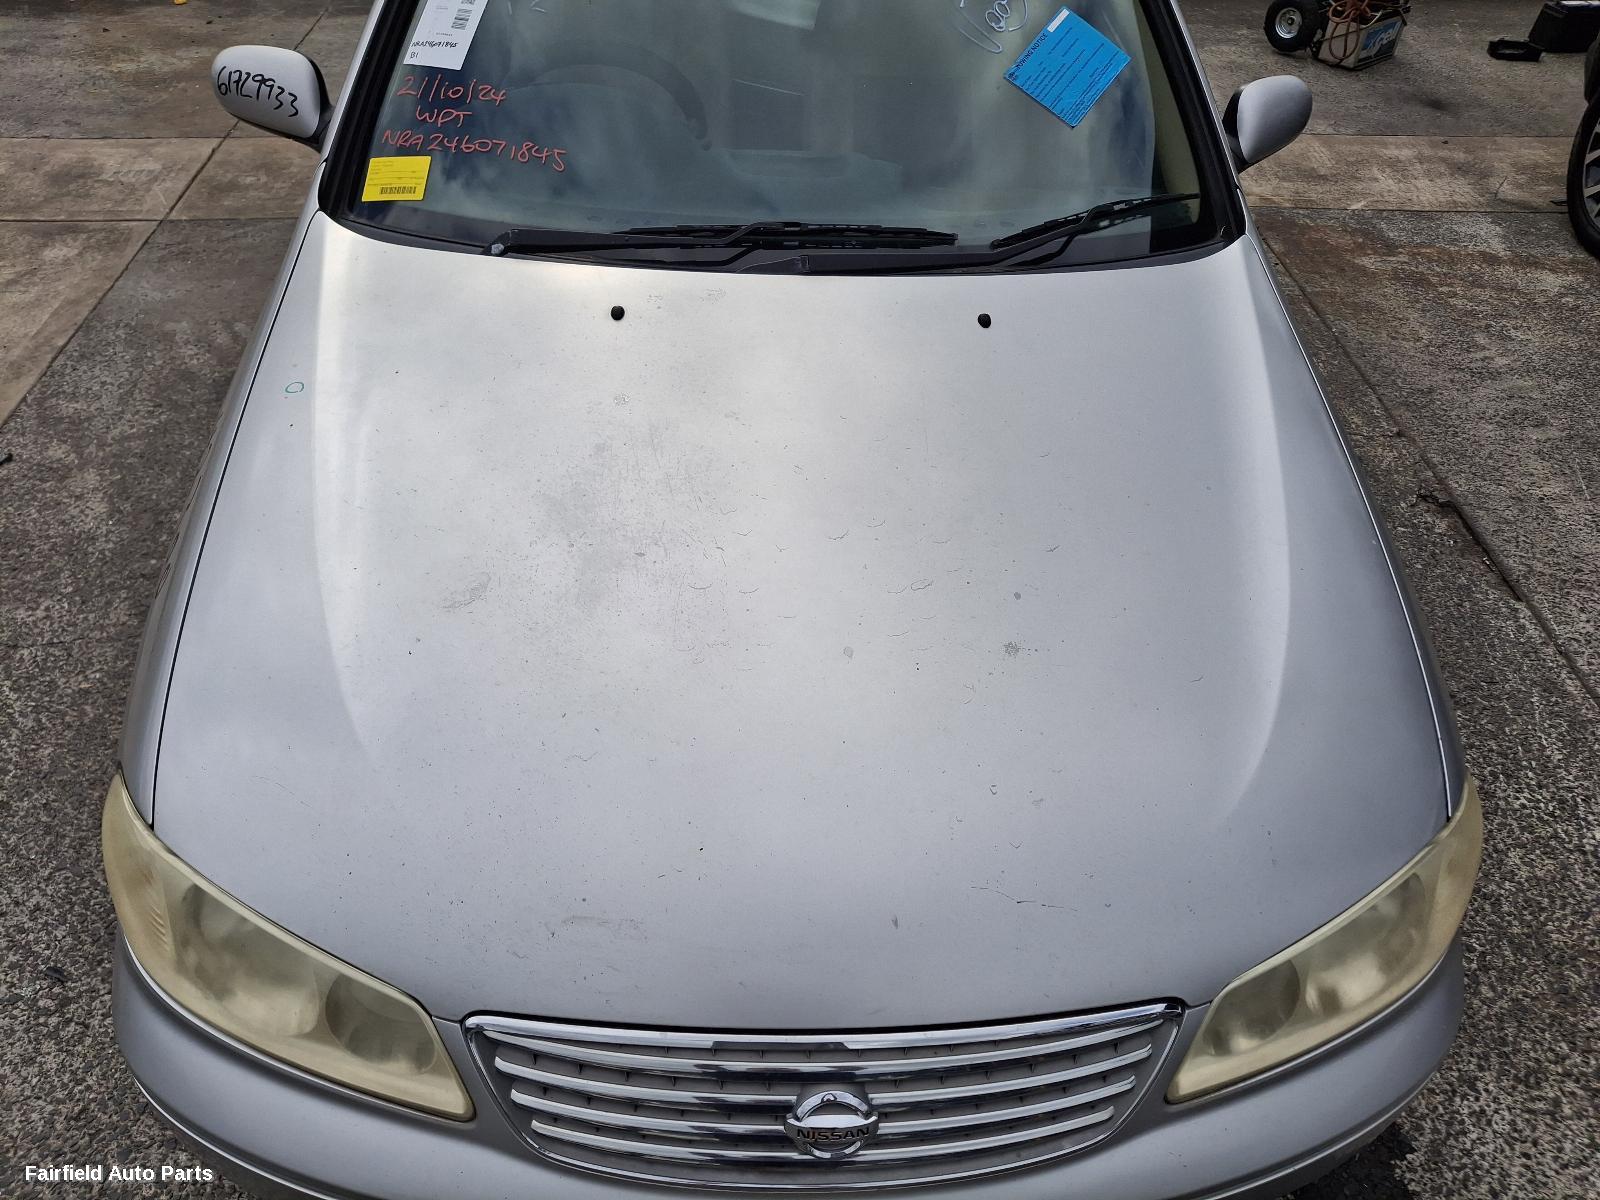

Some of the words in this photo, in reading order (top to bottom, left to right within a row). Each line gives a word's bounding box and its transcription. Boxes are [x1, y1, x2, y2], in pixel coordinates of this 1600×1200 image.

[1015, 49, 1034, 70] TOWING
[1030, 32, 1048, 53] NOTICE
[217, 65, 299, 118] 61729933
[396, 74, 507, 106] 21/10/24
[796, 1127, 870, 1142] NISSAN
